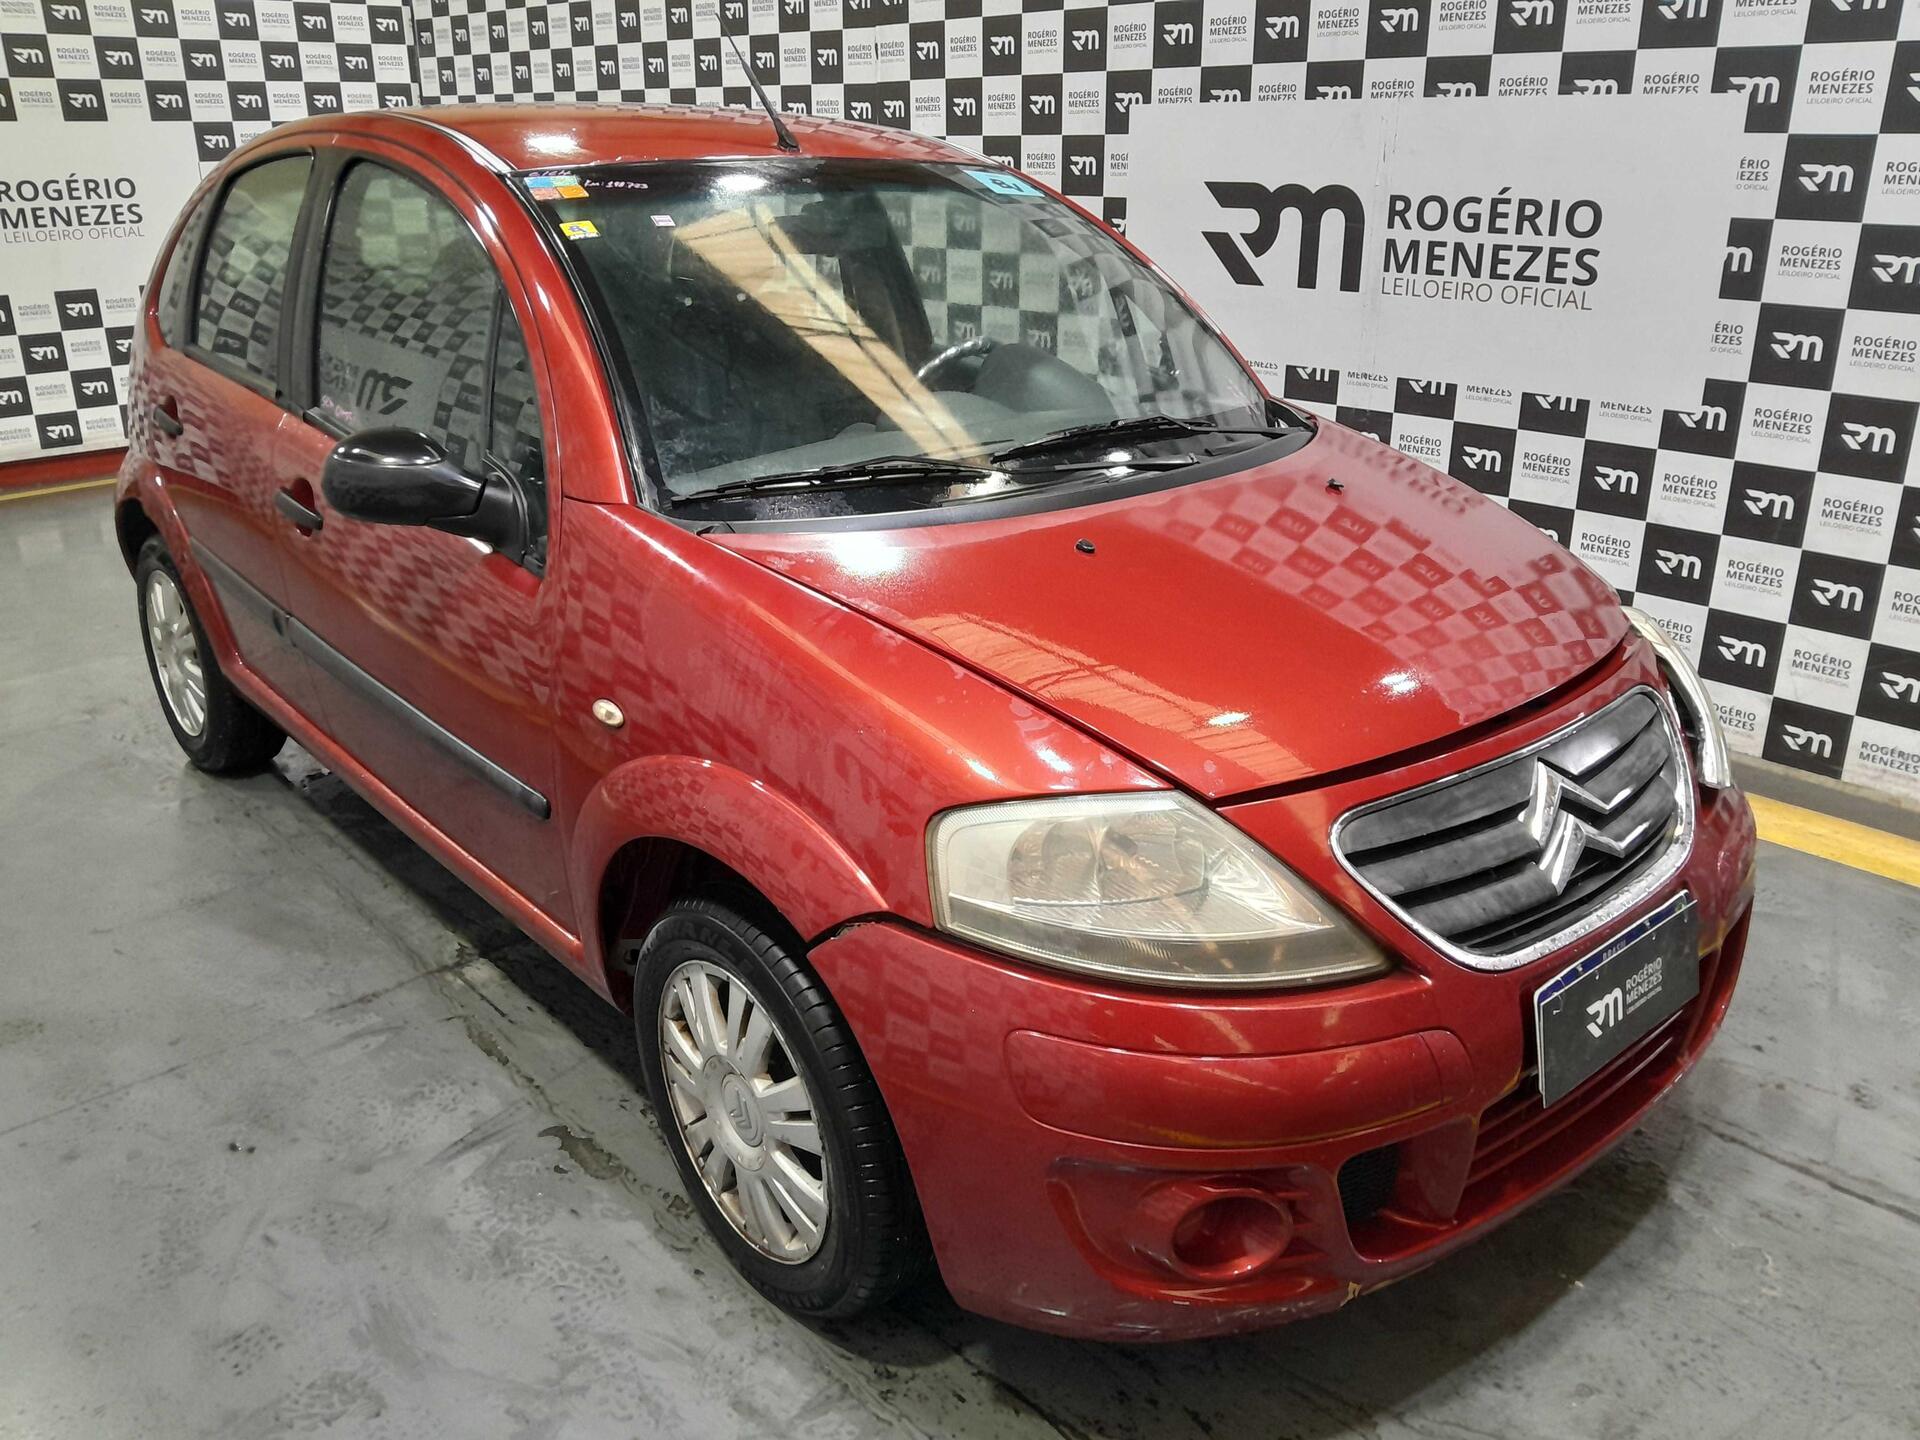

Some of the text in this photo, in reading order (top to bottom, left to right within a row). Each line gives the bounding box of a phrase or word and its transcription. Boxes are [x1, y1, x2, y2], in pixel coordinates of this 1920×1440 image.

[1440, 0, 1487, 12] ROGÉRIO
[1577, 3, 1631, 15] MENEZES
[1318, 7, 1359, 19] ROGÉRIO
[1439, 10, 1486, 22] MENEZES
[1210, 15, 1247, 26] ROGÉRIO
[1317, 18, 1359, 30] MENEZES
[1028, 29, 1057, 39] ROGÉRIO
[1114, 22, 1147, 33] ROGÉRIO
[1210, 25, 1247, 36] MENEZES
[950, 34, 976, 44] ROGÉRIO
[1028, 38, 1057, 47] MENEZES
[1114, 32, 1147, 42] MENEZES
[784, 47, 806, 55] ROGÉRIO
[880, 40, 904, 50] ROGÉRIO
[950, 44, 977, 52] MENEZES
[880, 49, 904, 57] MENEZES
[1499, 75, 1548, 87] ROGÉRIO
[1644, 72, 1700, 85] ROGÉRIO
[1810, 68, 1875, 82] ROGÉRIO
[1158, 85, 1192, 96] ROGÉRIO
[1259, 82, 1297, 93] ROGÉRIO
[1371, 78, 1415, 90] ROGÉRIO
[1808, 83, 1874, 94] MENEZES
[915, 95, 940, 104] ROGÉRIO
[988, 92, 1015, 102] ROGÉRIO
[1068, 89, 1099, 99] ROGÉRIO
[816, 99, 839, 107] ROGÉRIO
[915, 104, 941, 112] MENEZES
[988, 102, 1016, 110] MENEZES
[1068, 99, 1099, 108] MENEZES
[1026, 152, 1056, 161] ROGÉRIO
[1027, 161, 1055, 169] MENEZES
[0, 173, 136, 202] ROGÉRIO
[0, 203, 143, 229] MENEZES
[1387, 187, 1602, 238] ROGÉRIO
[4, 226, 144, 243] LEILOEIRO OFICIAL
[1781, 244, 1842, 258] ROGÉRIO
[1383, 238, 1600, 286] MENEZES
[1780, 257, 1841, 270] MENEZES
[1381, 277, 1592, 310] LEILOEIRO OFICIAL
[1854, 336, 1917, 351] ROGÉRIO
[1851, 347, 1916, 363] MENEZES
[1755, 408, 1813, 423] ROGÉRIO
[1753, 418, 1812, 435] MENEZES
[1399, 434, 1441, 447] ROGÉRIO
[1399, 443, 1441, 457] MENEZES
[1523, 452, 1571, 467] ROGÉRIO
[1522, 461, 1570, 476] MENEZES
[1664, 473, 1718, 489] ROGÉRIO
[1662, 483, 1716, 500] MENEZES
[1823, 498, 1884, 516] ROGÉRIO
[1821, 508, 1882, 527] MENEZES
[1582, 532, 1631, 549] ROGÉRIO
[1580, 542, 1630, 559] MENEZES
[1728, 559, 1784, 578] ROGÉRIO
[1726, 569, 1783, 588] MENEZES
[1794, 649, 1852, 669] ROGÉRIO
[1792, 659, 1850, 680] MENEZES
[1713, 703, 1756, 722] OGÉRIO
[1718, 716, 1755, 731] NEZES
[1861, 741, 1920, 763] ROGÉRIO
[1859, 751, 1920, 774] MENEZES
[1626, 957, 1662, 991] ROGÉRIO
[1626, 970, 1662, 1004] MENEZES
